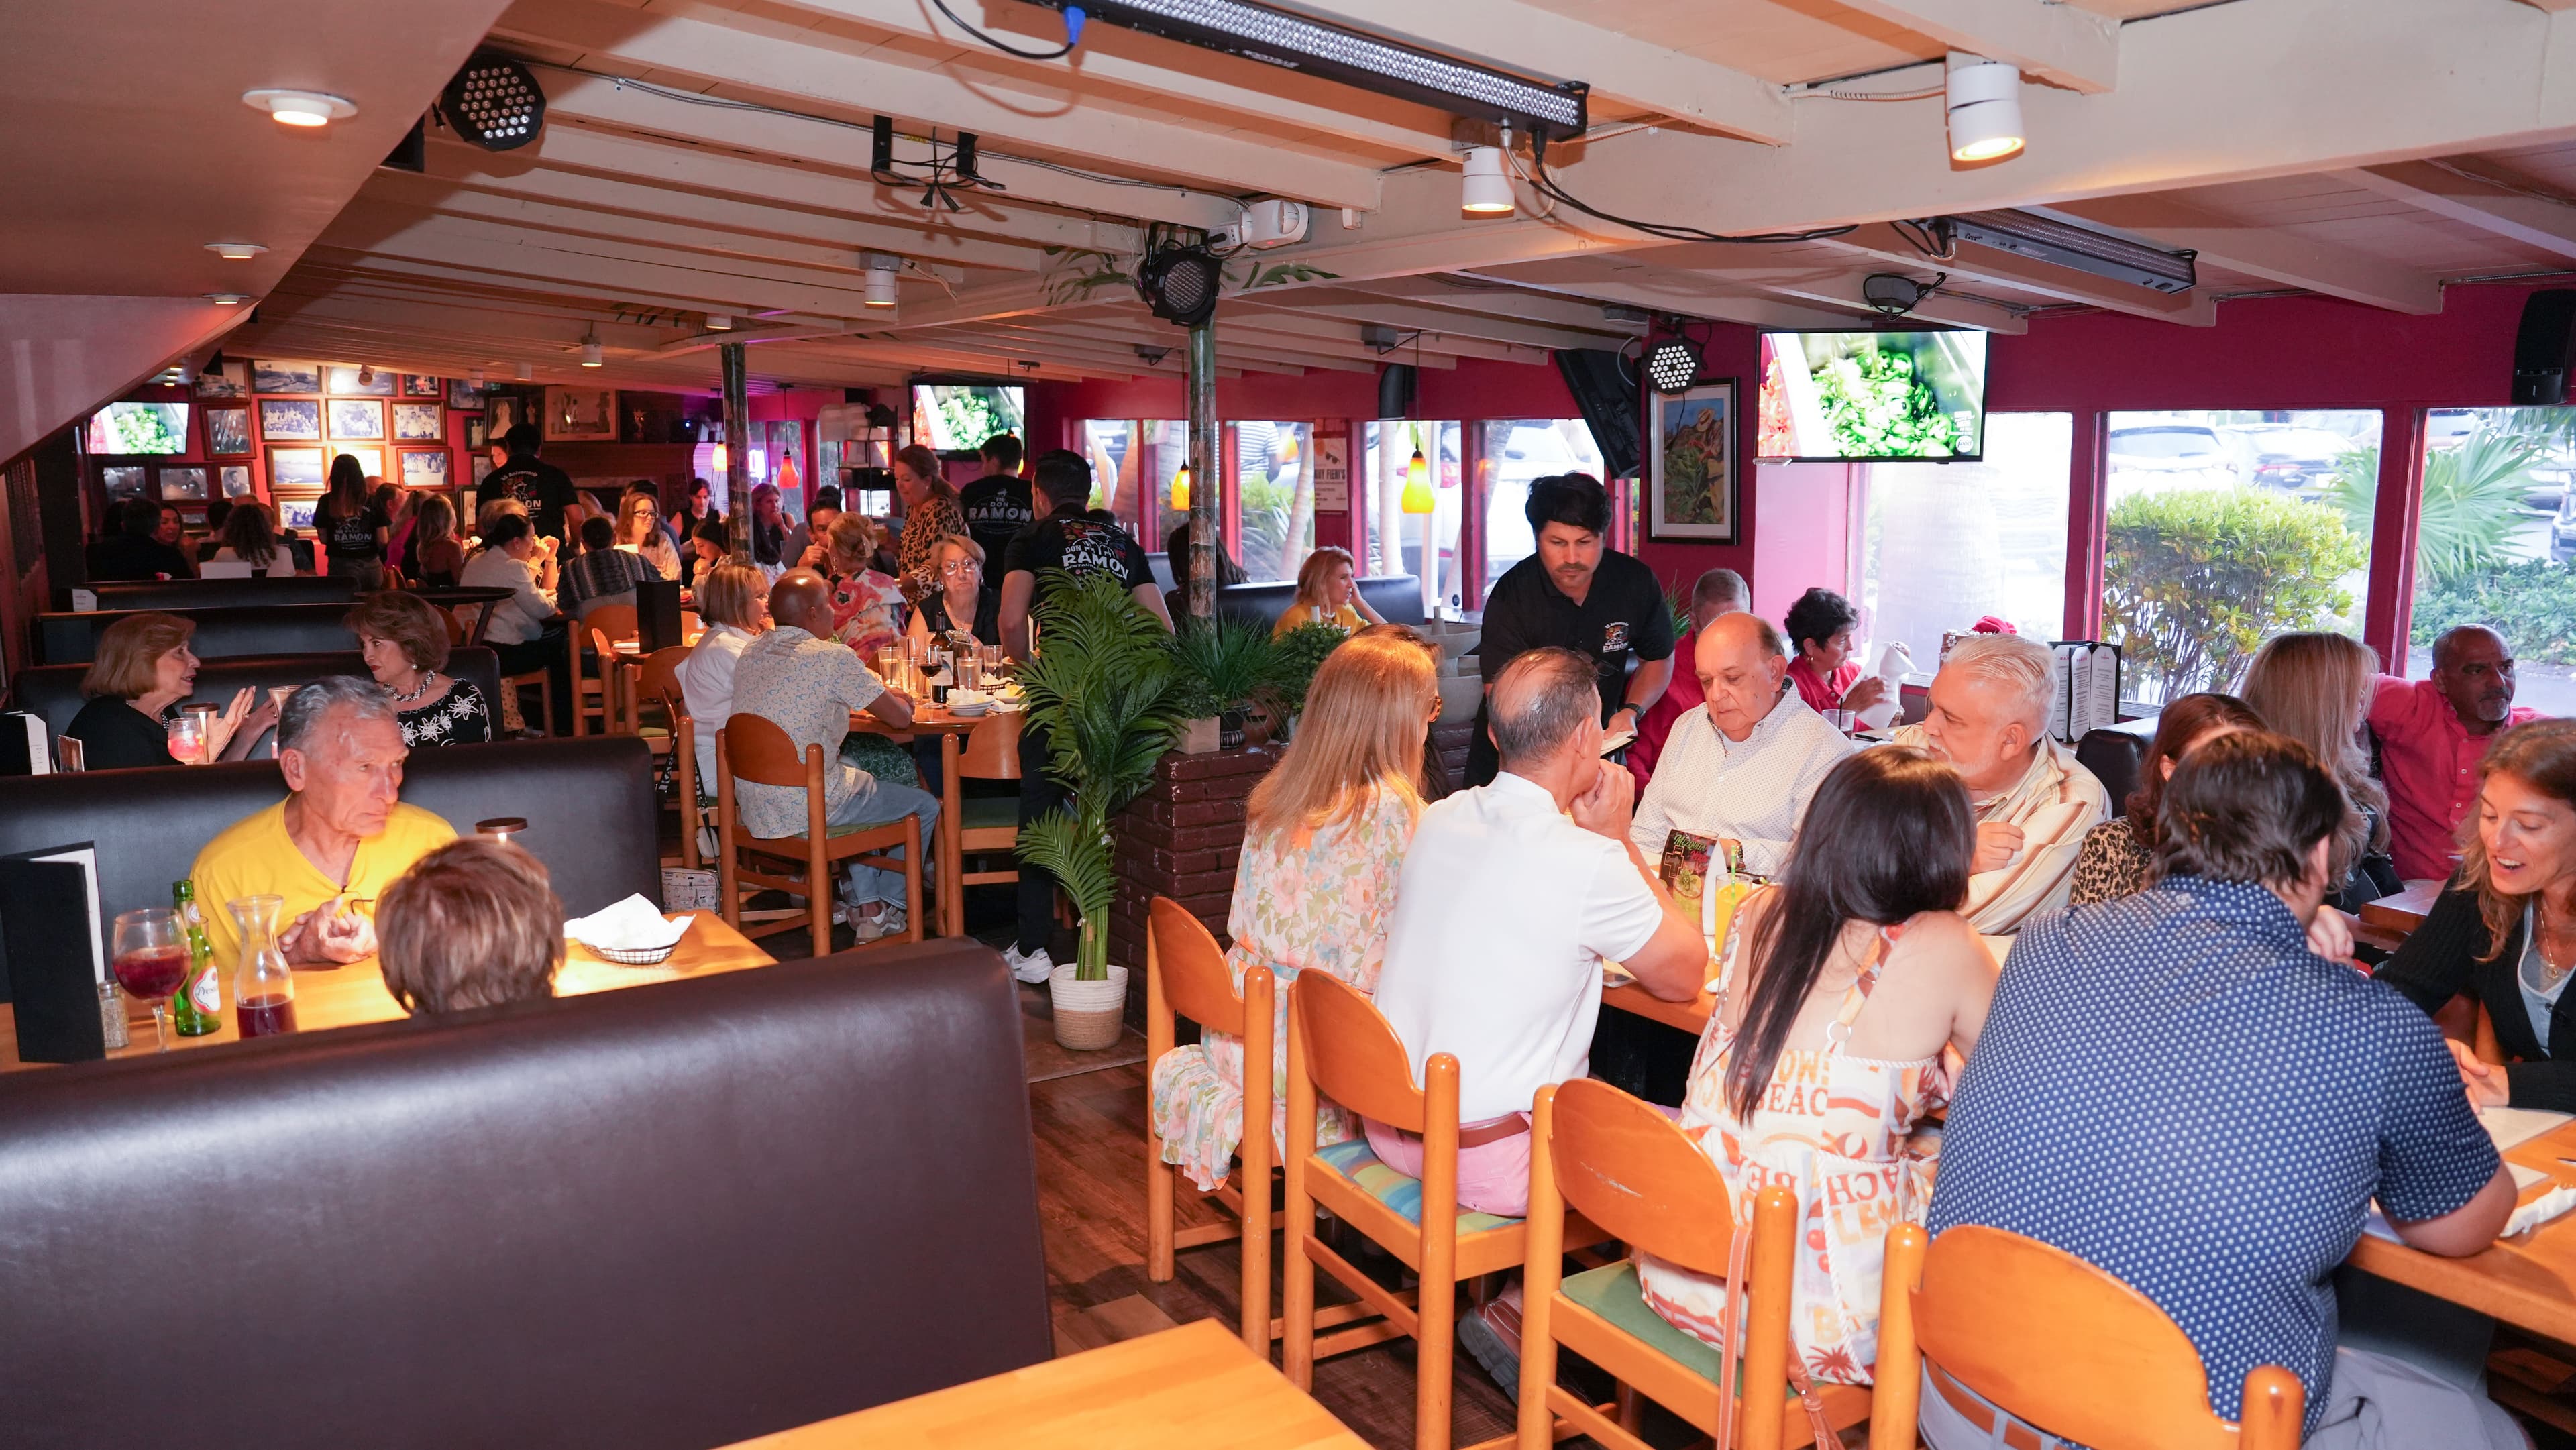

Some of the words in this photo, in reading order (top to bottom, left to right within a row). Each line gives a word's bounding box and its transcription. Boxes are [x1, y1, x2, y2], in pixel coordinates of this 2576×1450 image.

[969, 507, 1032, 522] RAMON
[334, 533, 372, 542] RAMON
[1065, 545, 1081, 553] DON
